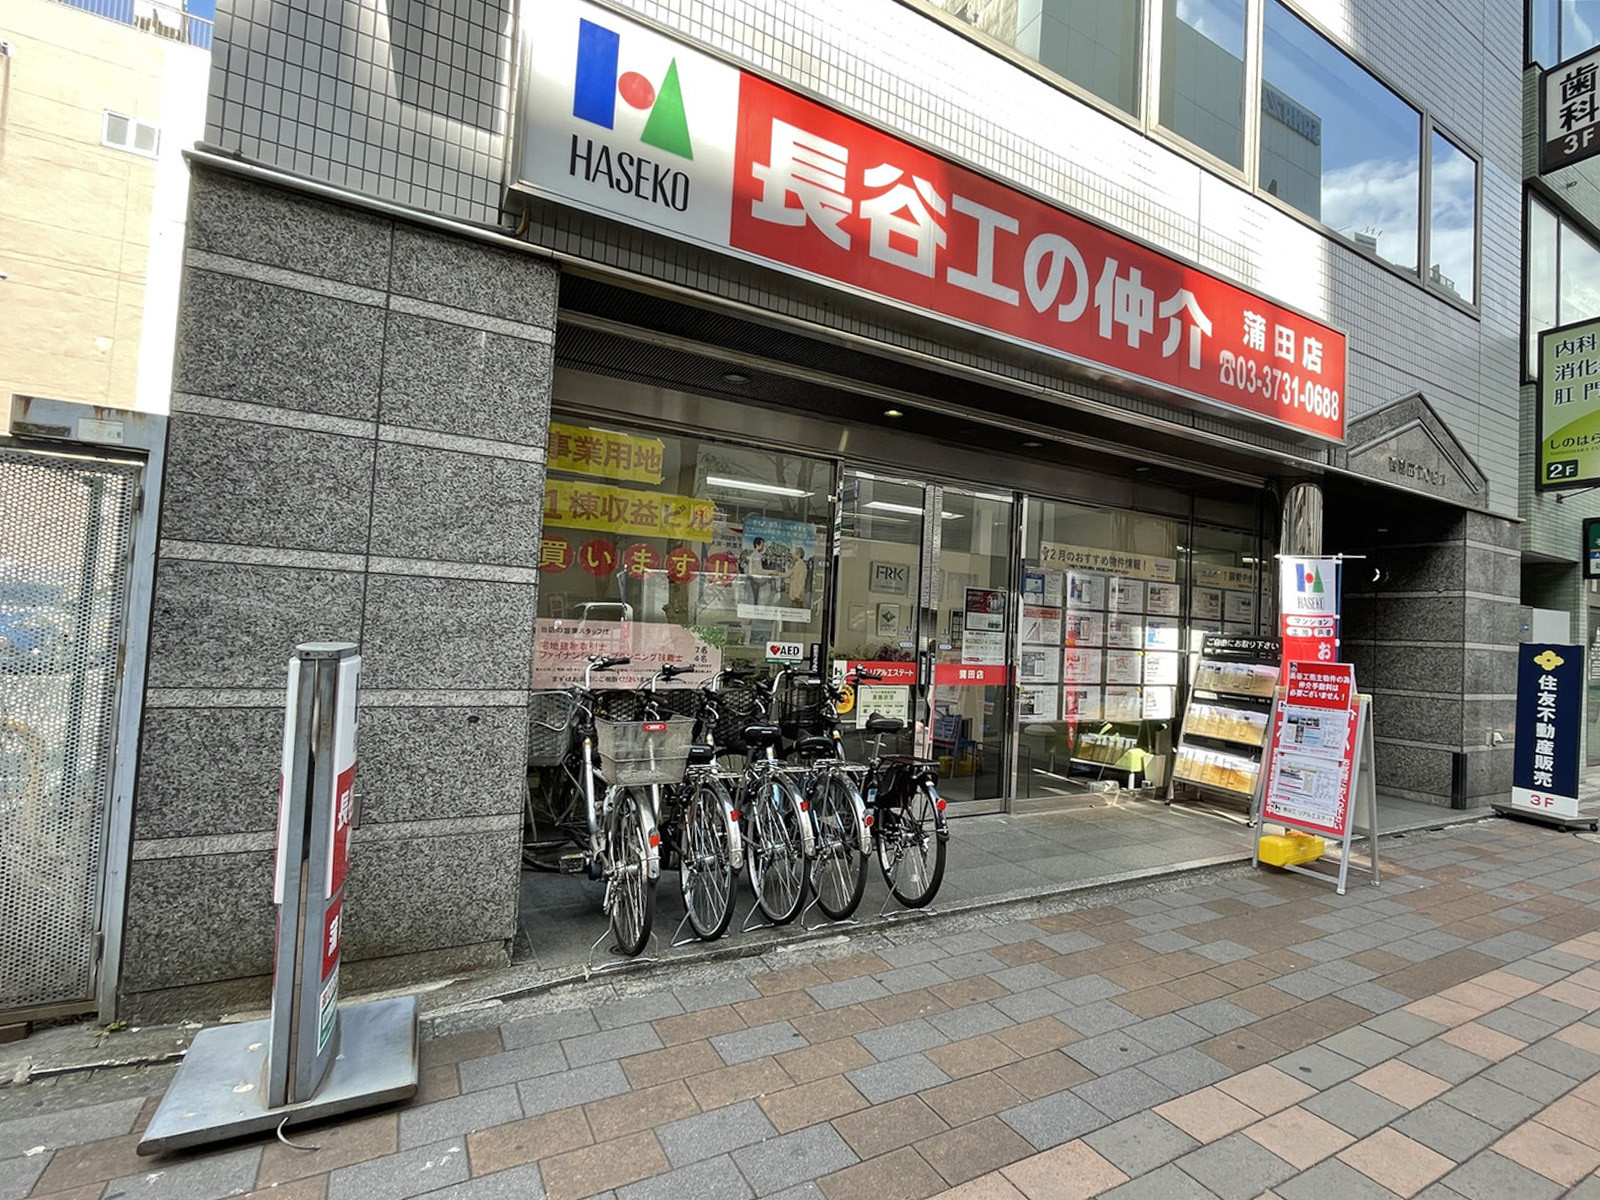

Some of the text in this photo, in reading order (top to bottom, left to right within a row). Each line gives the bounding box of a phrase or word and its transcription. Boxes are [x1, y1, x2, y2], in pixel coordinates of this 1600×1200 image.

[1559, 62, 1600, 132] 歯科
[1563, 128, 1595, 154] 3F
[569, 134, 690, 212] HASEKO
[751, 117, 1213, 371] 長谷工の仲介
[1242, 309, 1324, 375] 蒲田店
[1555, 333, 1597, 359] 内科
[1554, 359, 1600, 382] 消化
[1236, 359, 1340, 422] 03-3731-0688
[548, 431, 661, 475] 事業用地
[1549, 462, 1576, 479] 2F
[876, 565, 904, 581] FRK
[780, 646, 800, 656] AED
[1532, 674, 1558, 788] 住友不動産販売
[1529, 793, 1555, 808] 3F
